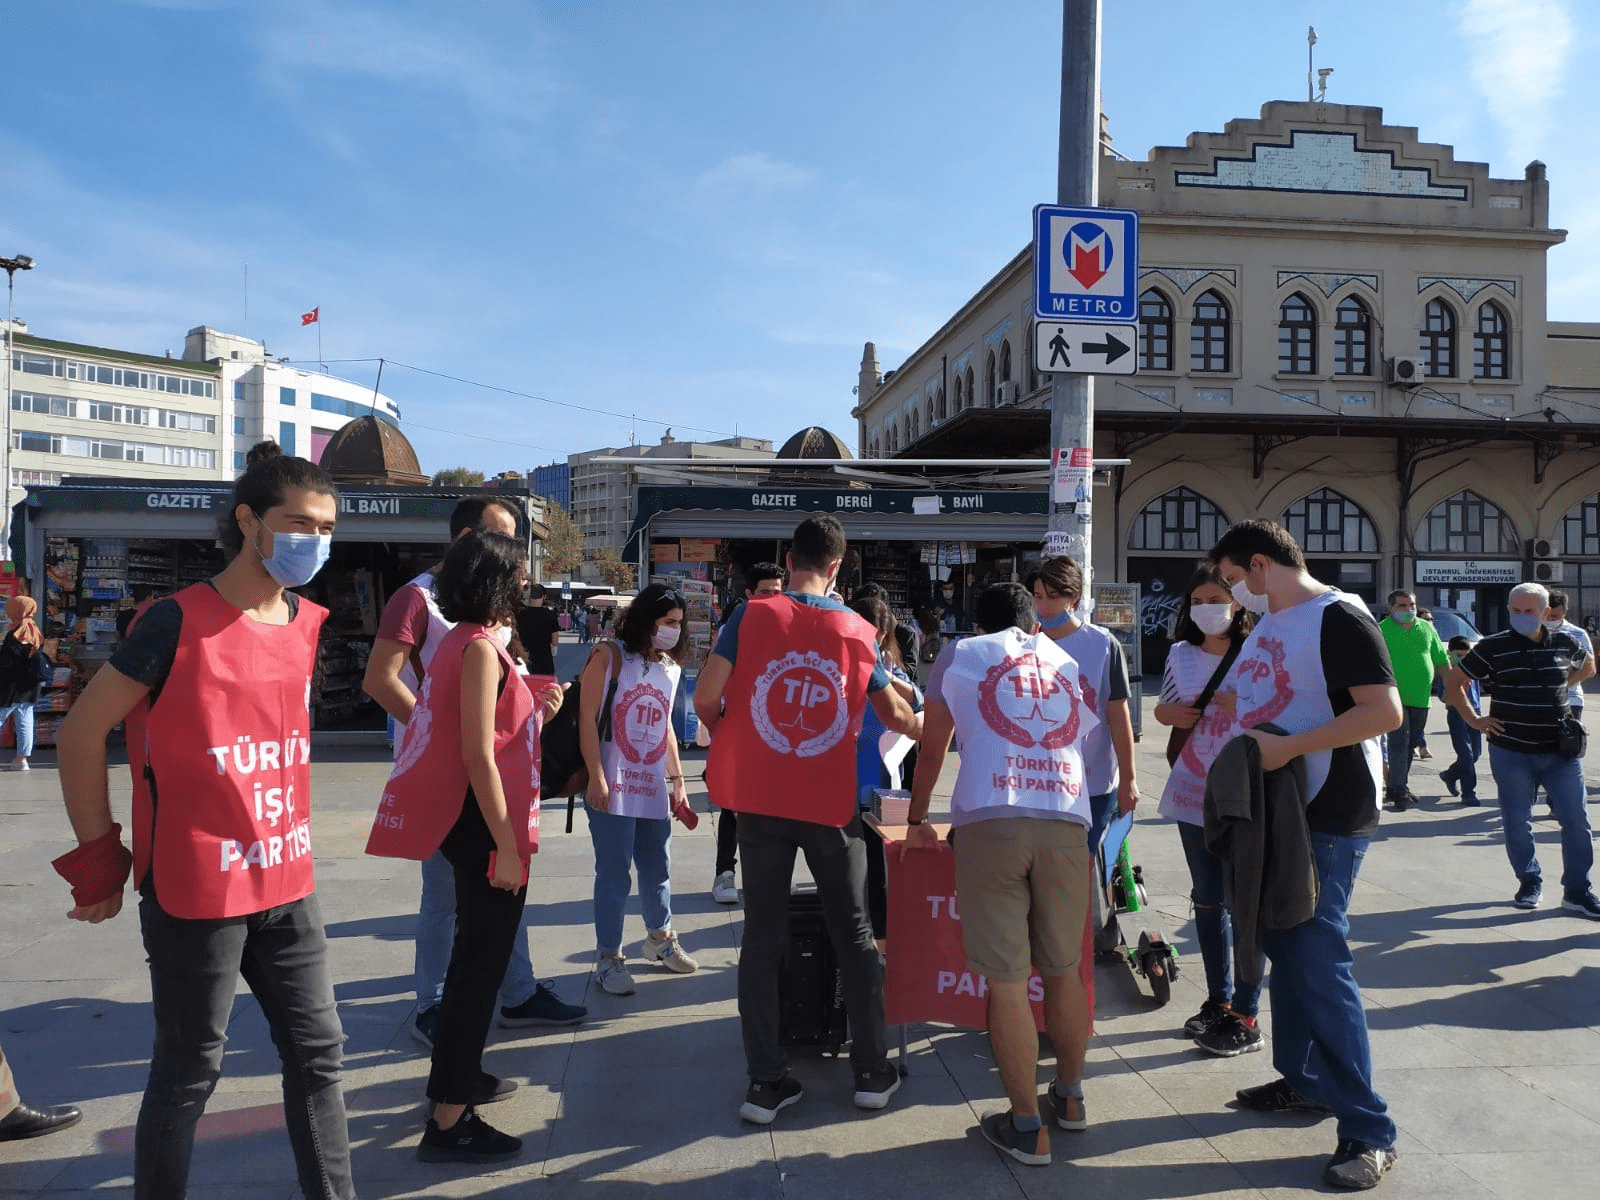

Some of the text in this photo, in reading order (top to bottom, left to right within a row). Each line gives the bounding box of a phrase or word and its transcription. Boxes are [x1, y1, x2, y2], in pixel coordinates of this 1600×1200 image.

[1052, 298, 1122, 314] METRO
[146, 493, 211, 509] GAZETE
[358, 498, 400, 514] BAYİİ
[751, 494, 797, 507] GAZETE
[836, 494, 873, 508] DERGİ
[953, 494, 984, 508] BAYİİ
[762, 657, 797, 685] TÜRKİYE
[803, 655, 822, 667] İŞÇİ
[783, 675, 830, 708] TİP
[1007, 672, 1061, 700] TİP
[636, 701, 662, 728] TİP
[1005, 754, 1072, 775] TÜRKİYE
[992, 773, 1082, 797] İŞÇİ PARTİSİ
